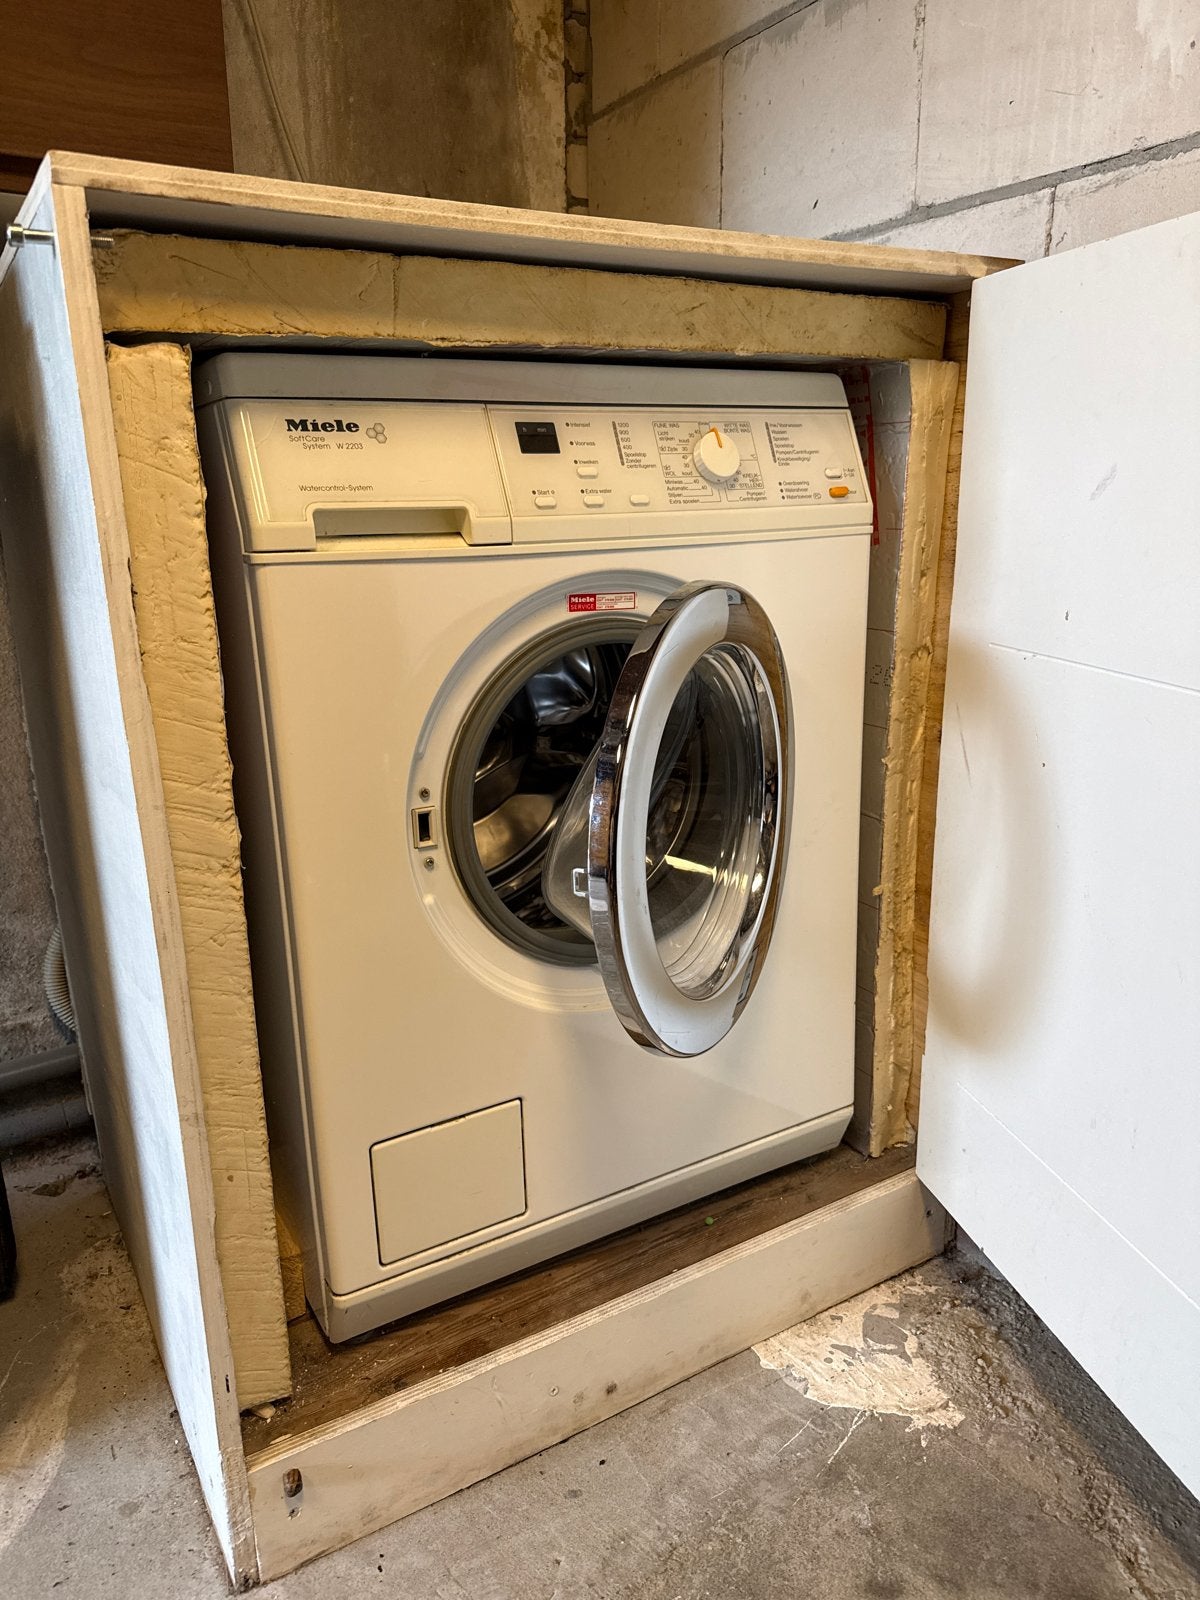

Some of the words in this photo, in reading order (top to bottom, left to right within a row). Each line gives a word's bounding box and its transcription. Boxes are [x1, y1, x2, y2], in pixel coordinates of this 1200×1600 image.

[285, 418, 360, 433] Miele
[303, 442, 331, 450] System
[335, 442, 344, 450] W
[345, 442, 364, 450] 2203
[298, 484, 374, 493] Watercontrol-System
